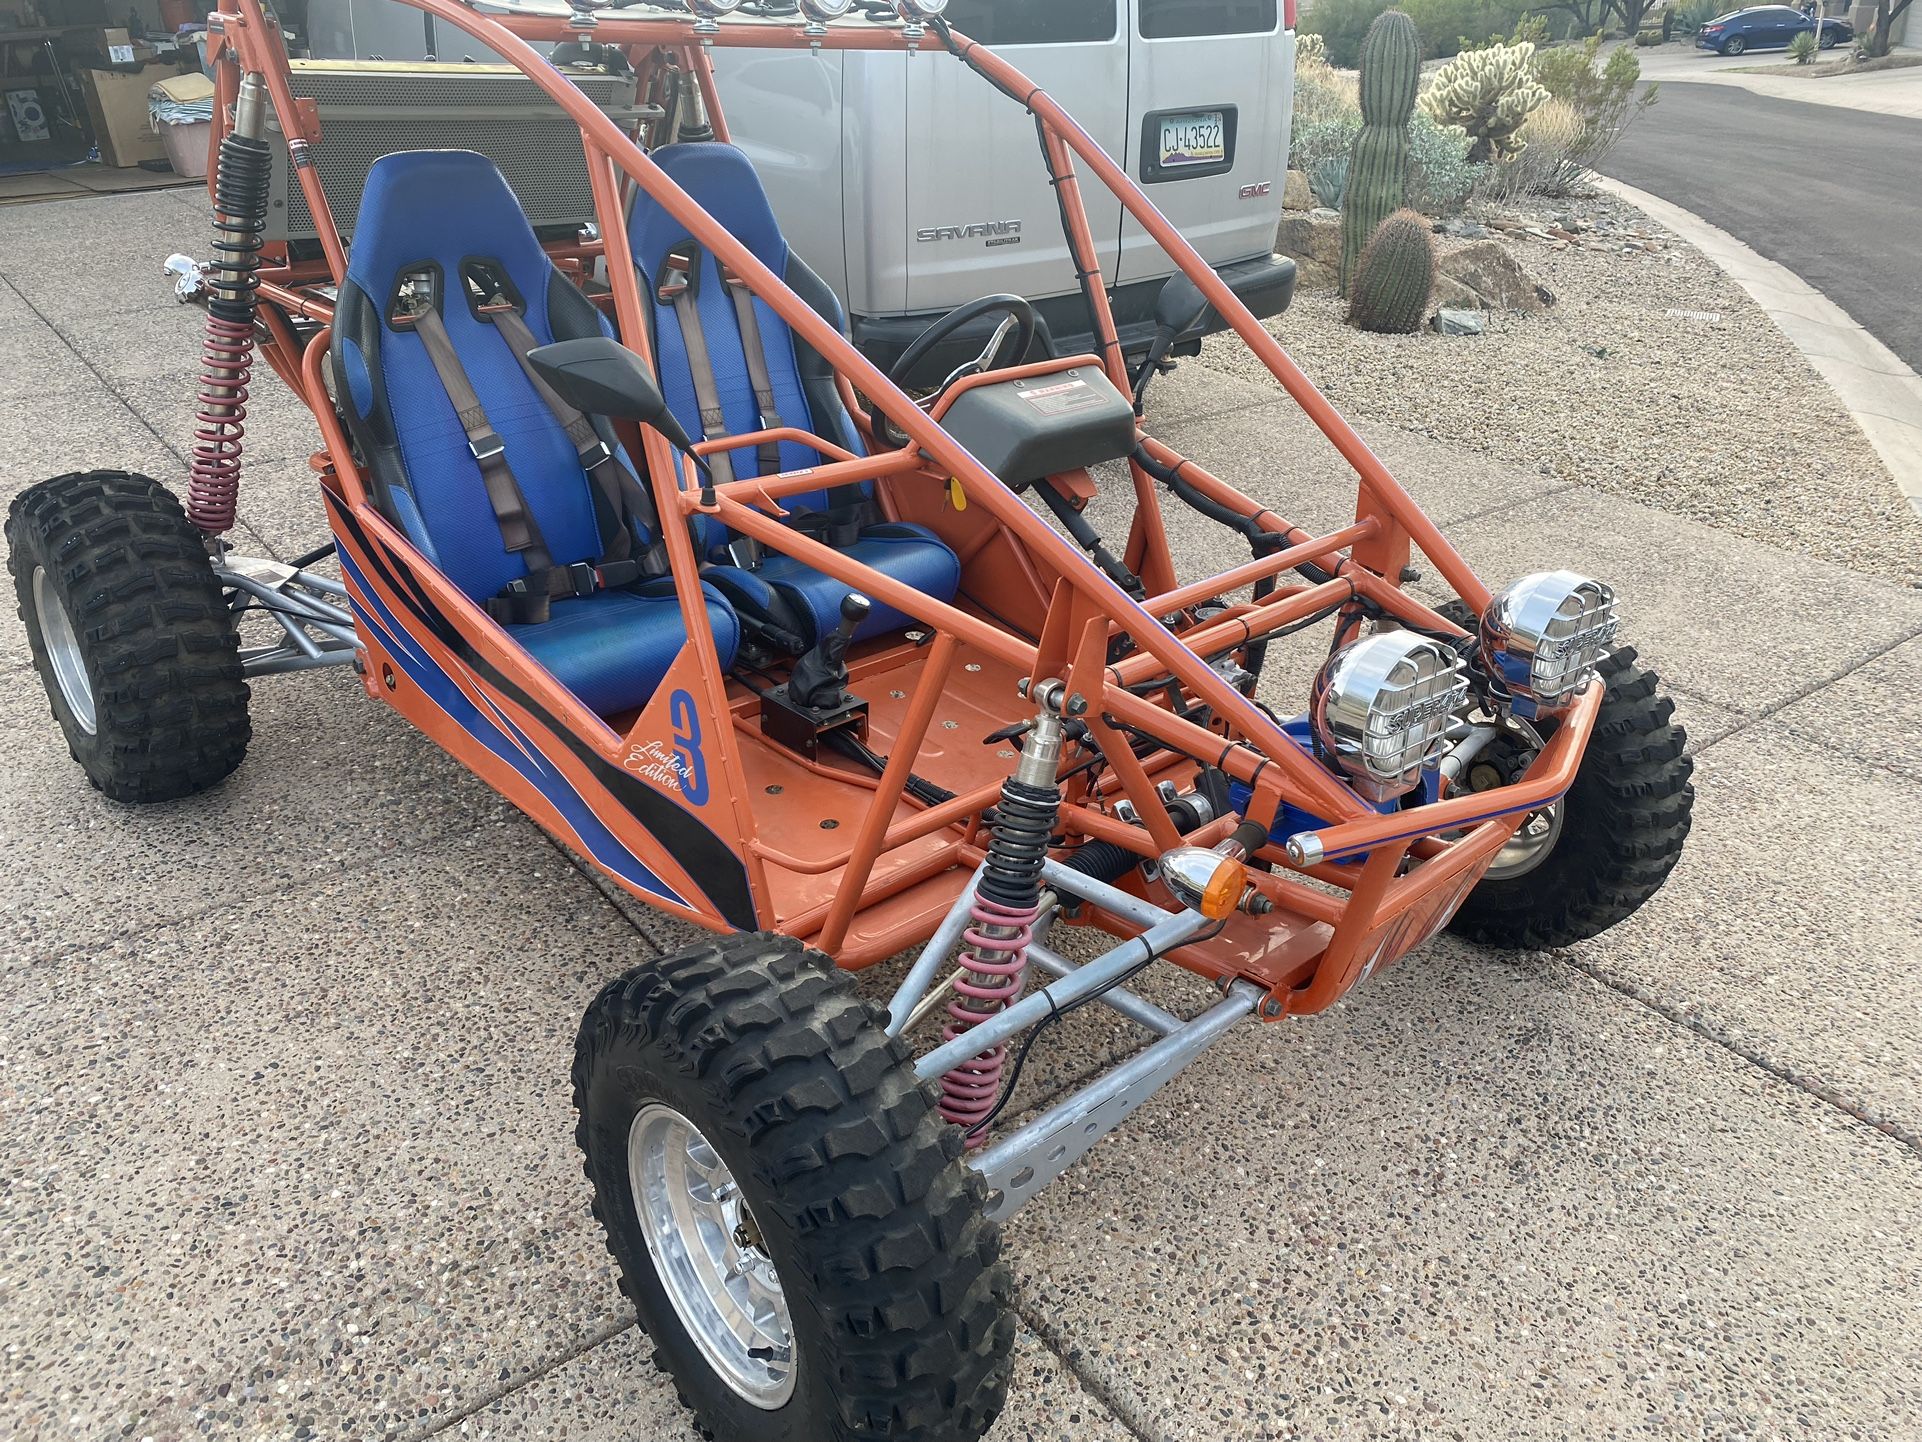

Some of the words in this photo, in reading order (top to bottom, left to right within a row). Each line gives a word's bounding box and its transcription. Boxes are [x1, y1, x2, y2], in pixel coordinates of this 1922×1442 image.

[1239, 181, 1271, 200] GMC
[917, 219, 1021, 242] SAVANA
[623, 752, 687, 792] Edition
[631, 740, 693, 778] Limited
